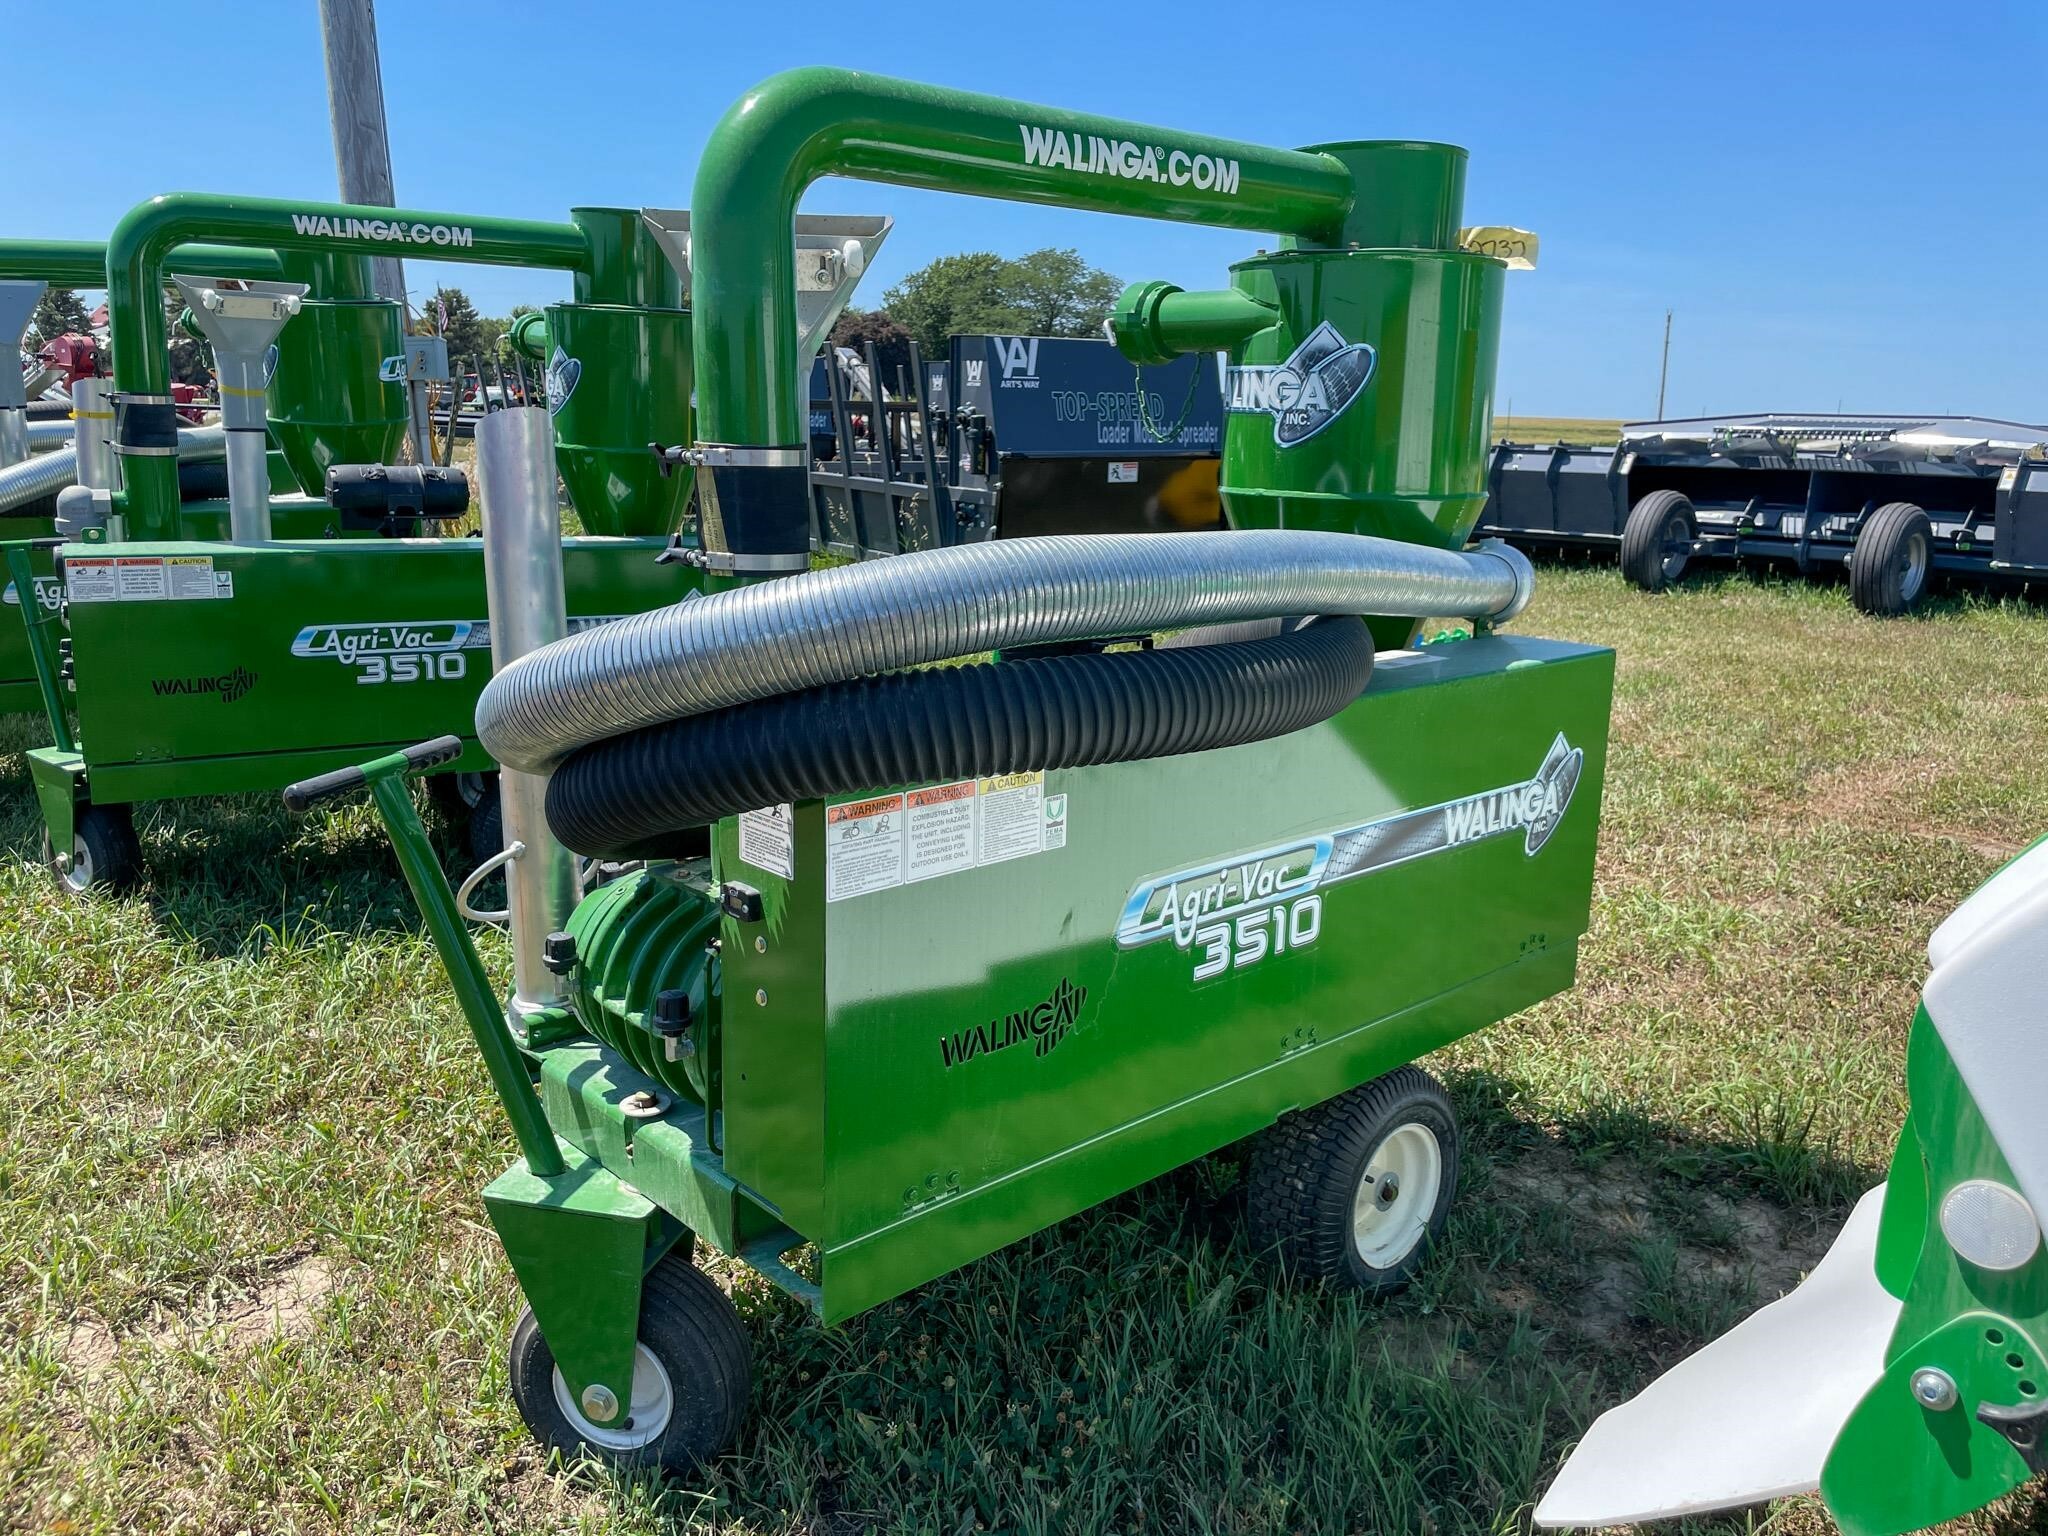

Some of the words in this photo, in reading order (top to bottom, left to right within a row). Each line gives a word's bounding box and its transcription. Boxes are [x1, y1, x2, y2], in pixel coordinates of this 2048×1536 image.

[1023, 380, 1040, 389] WAY
[1286, 413, 1311, 426] INC.
[1097, 420, 1130, 443] Loader
[1134, 420, 1174, 443] Mouted
[178, 557, 207, 565] CAUTION
[324, 627, 434, 665] Agri-Vac
[355, 652, 467, 685] 3510
[151, 675, 250, 696] WALINGA
[997, 773, 1036, 789] CAUTION
[927, 784, 969, 803] WARNING
[849, 798, 897, 817] WARNING
[912, 808, 953, 822] COMBUSTIBLE
[954, 804, 970, 814] DUST
[1444, 780, 1559, 846] WALINGA
[911, 819, 945, 832] EXPLOSION
[911, 832, 923, 841] THE
[940, 822, 971, 835] INCLUDING
[1046, 826, 1064, 835] FEMA
[1533, 817, 1548, 834] INC.
[916, 836, 950, 849] CONVEYING
[916, 851, 923, 859] IS
[923, 846, 953, 857] DESIGNED
[953, 841, 966, 850] FOR
[910, 856, 940, 869] OUTDOOR
[940, 853, 953, 862] USE
[1158, 861, 1290, 947] Agri-Vac
[1193, 894, 1322, 982] 3510
[940, 994, 1076, 1069] WALINGA
